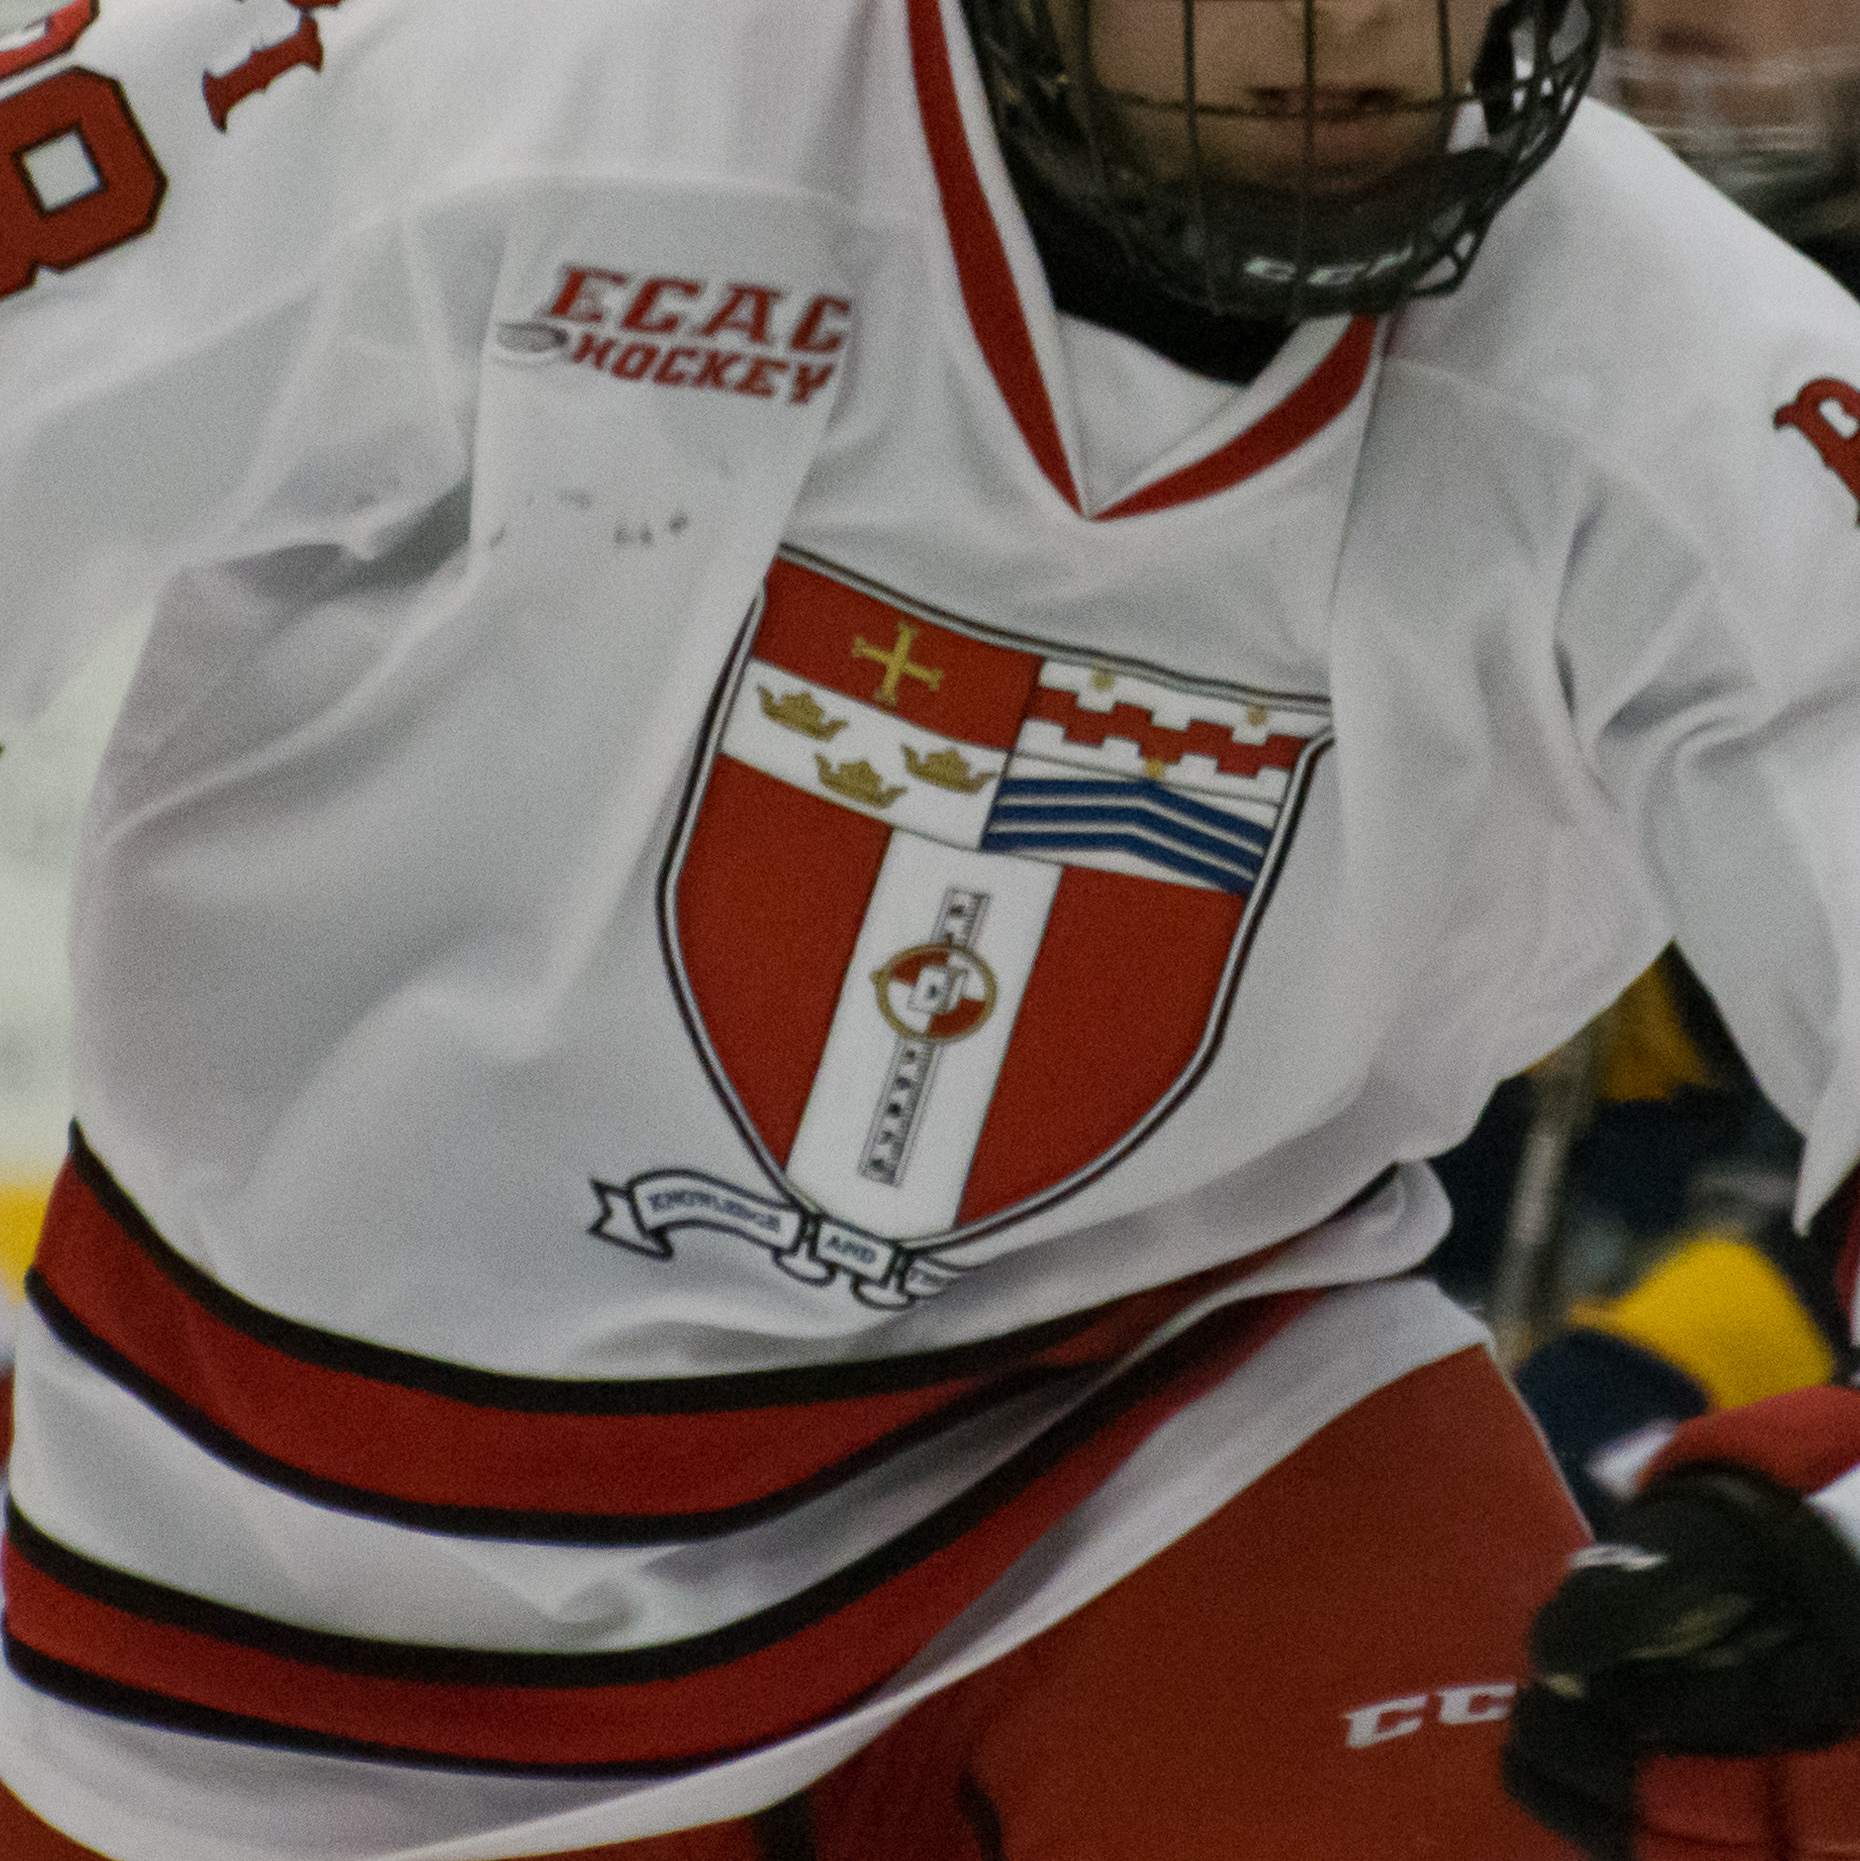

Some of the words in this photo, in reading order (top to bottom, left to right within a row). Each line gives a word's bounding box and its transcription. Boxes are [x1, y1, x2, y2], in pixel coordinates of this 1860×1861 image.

[549, 262, 852, 354] ECAC
[571, 332, 835, 406] HOCKEY
[1344, 1681, 1517, 1748] CC
